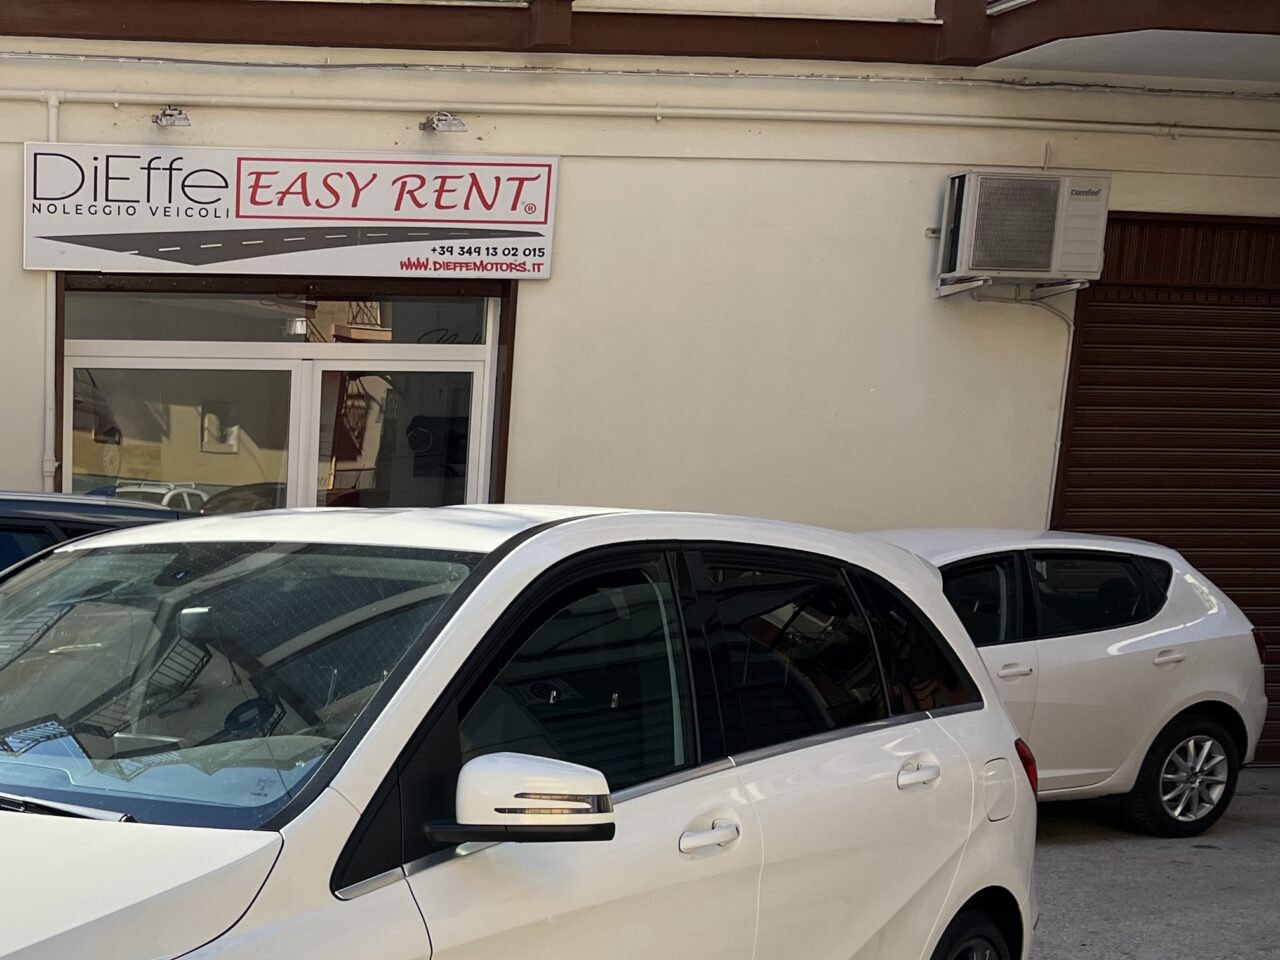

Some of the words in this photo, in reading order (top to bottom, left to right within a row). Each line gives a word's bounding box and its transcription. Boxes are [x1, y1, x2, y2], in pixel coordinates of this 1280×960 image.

[33, 152, 229, 205] DiEffe
[247, 170, 378, 209] EASY
[32, 202, 137, 216] NOLEGGIO
[149, 206, 230, 219] VEICOLI
[430, 246, 454, 256] +39
[458, 246, 481, 257] 349
[485, 247, 498, 257] 13
[502, 247, 519, 257] 02
[523, 247, 545, 258] 015
[400, 257, 544, 273] WWW.DIEFFEMOTORS.IT
